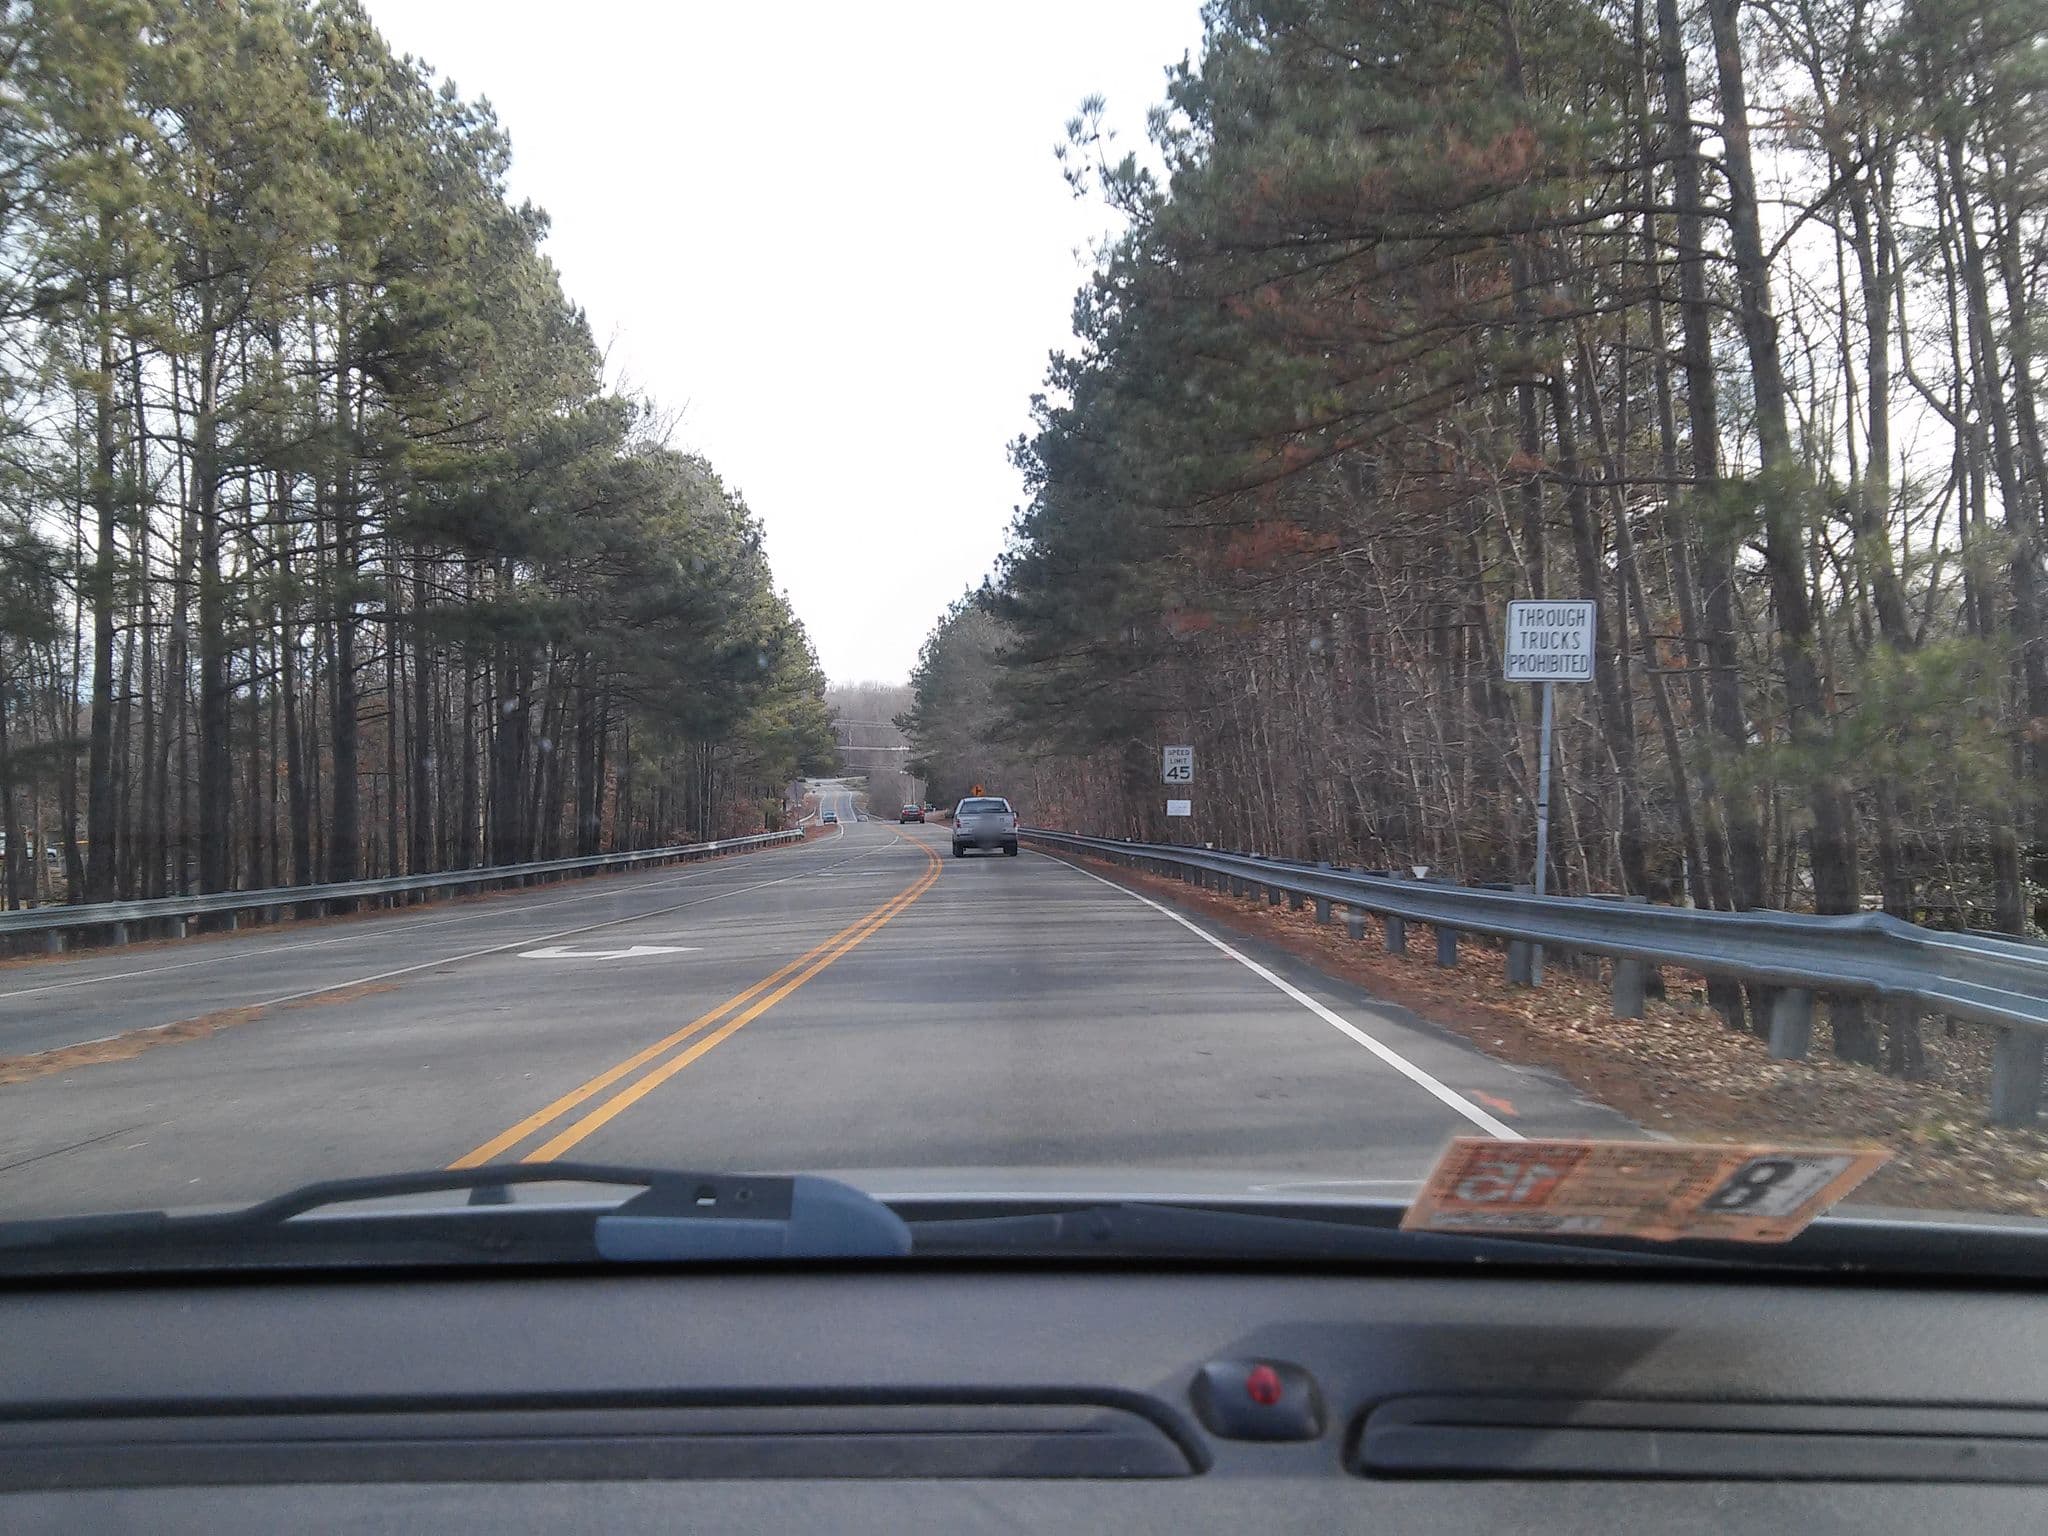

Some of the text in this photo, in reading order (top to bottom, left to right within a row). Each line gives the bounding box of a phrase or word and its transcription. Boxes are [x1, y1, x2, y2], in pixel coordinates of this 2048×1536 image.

[1518, 608, 1586, 627] THROUGH
[1520, 631, 1581, 650] TRUCKS
[1509, 654, 1588, 673] PROHIBITED
[1166, 766, 1190, 780] 45
